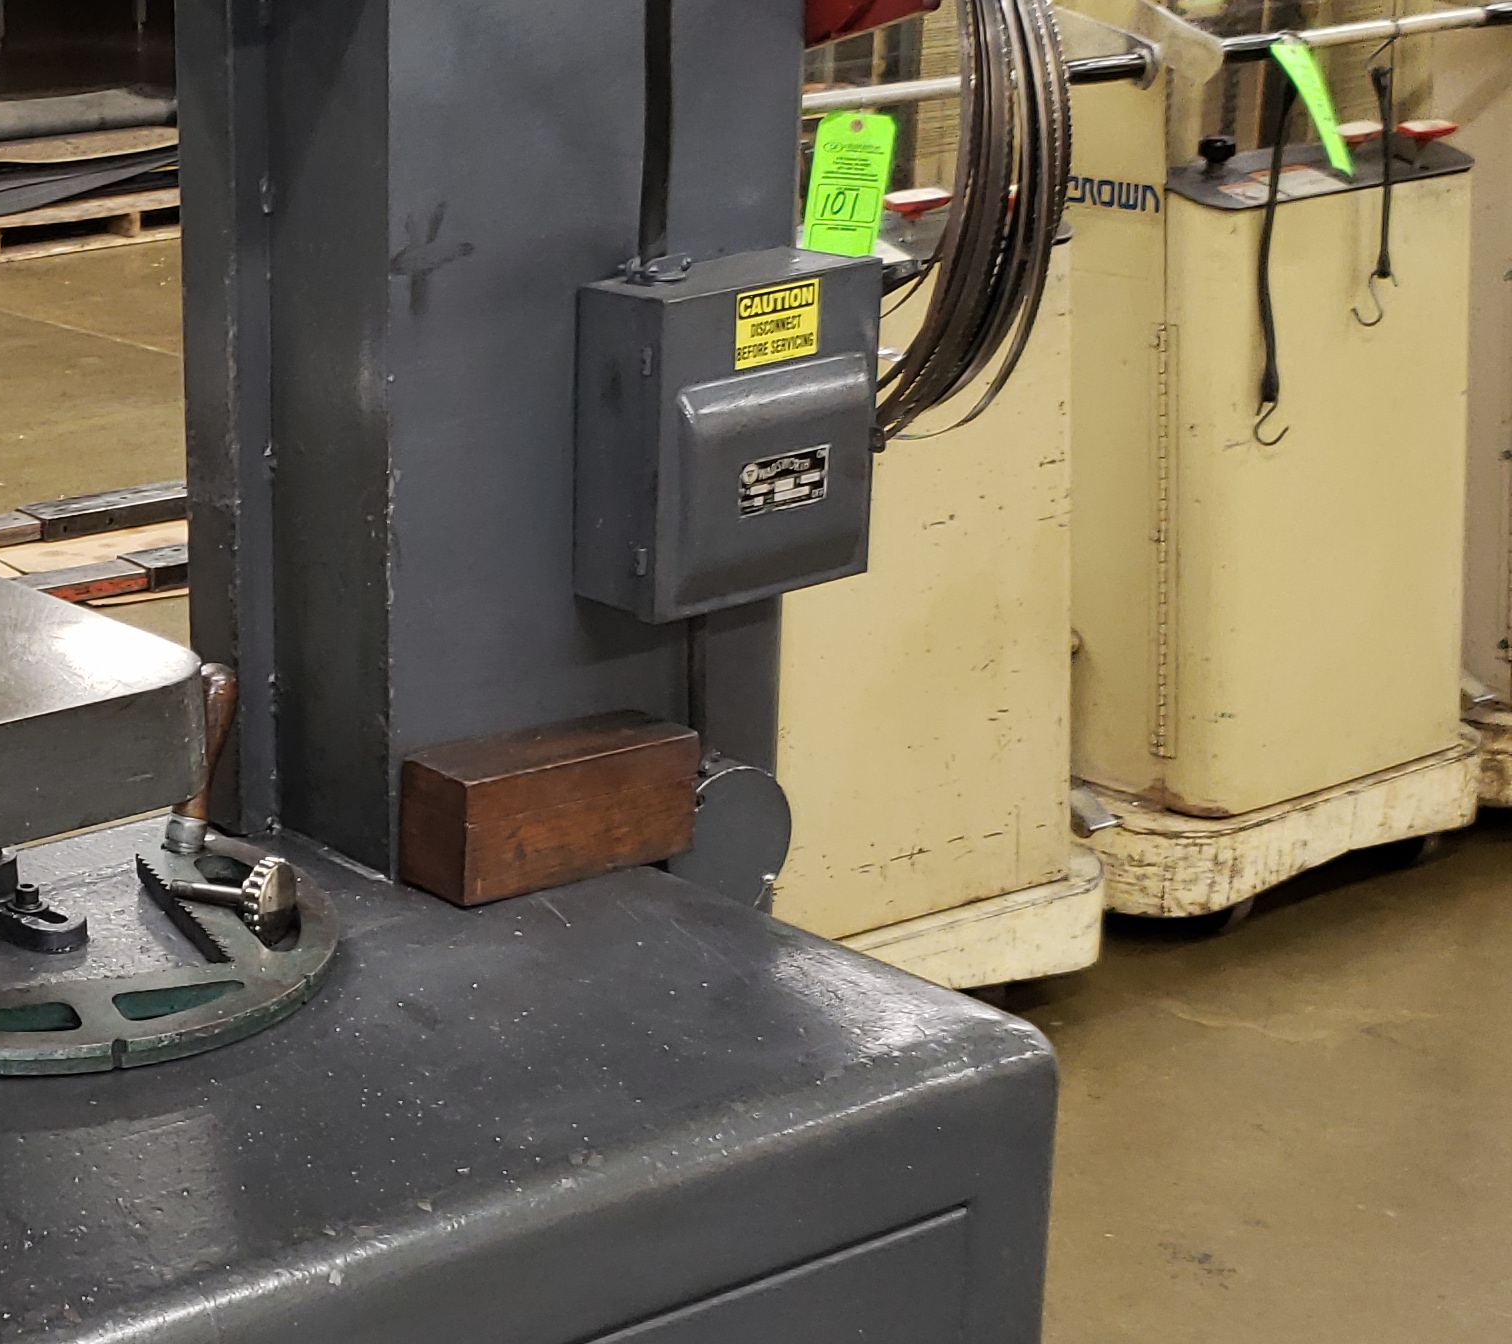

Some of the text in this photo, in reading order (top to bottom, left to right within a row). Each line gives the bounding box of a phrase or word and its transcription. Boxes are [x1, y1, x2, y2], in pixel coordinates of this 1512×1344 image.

[820, 190, 860, 221] 101
[739, 285, 815, 318] CAUTION
[750, 313, 802, 339] DISCONNECT
[736, 331, 814, 362] BEFORE SERVICING
